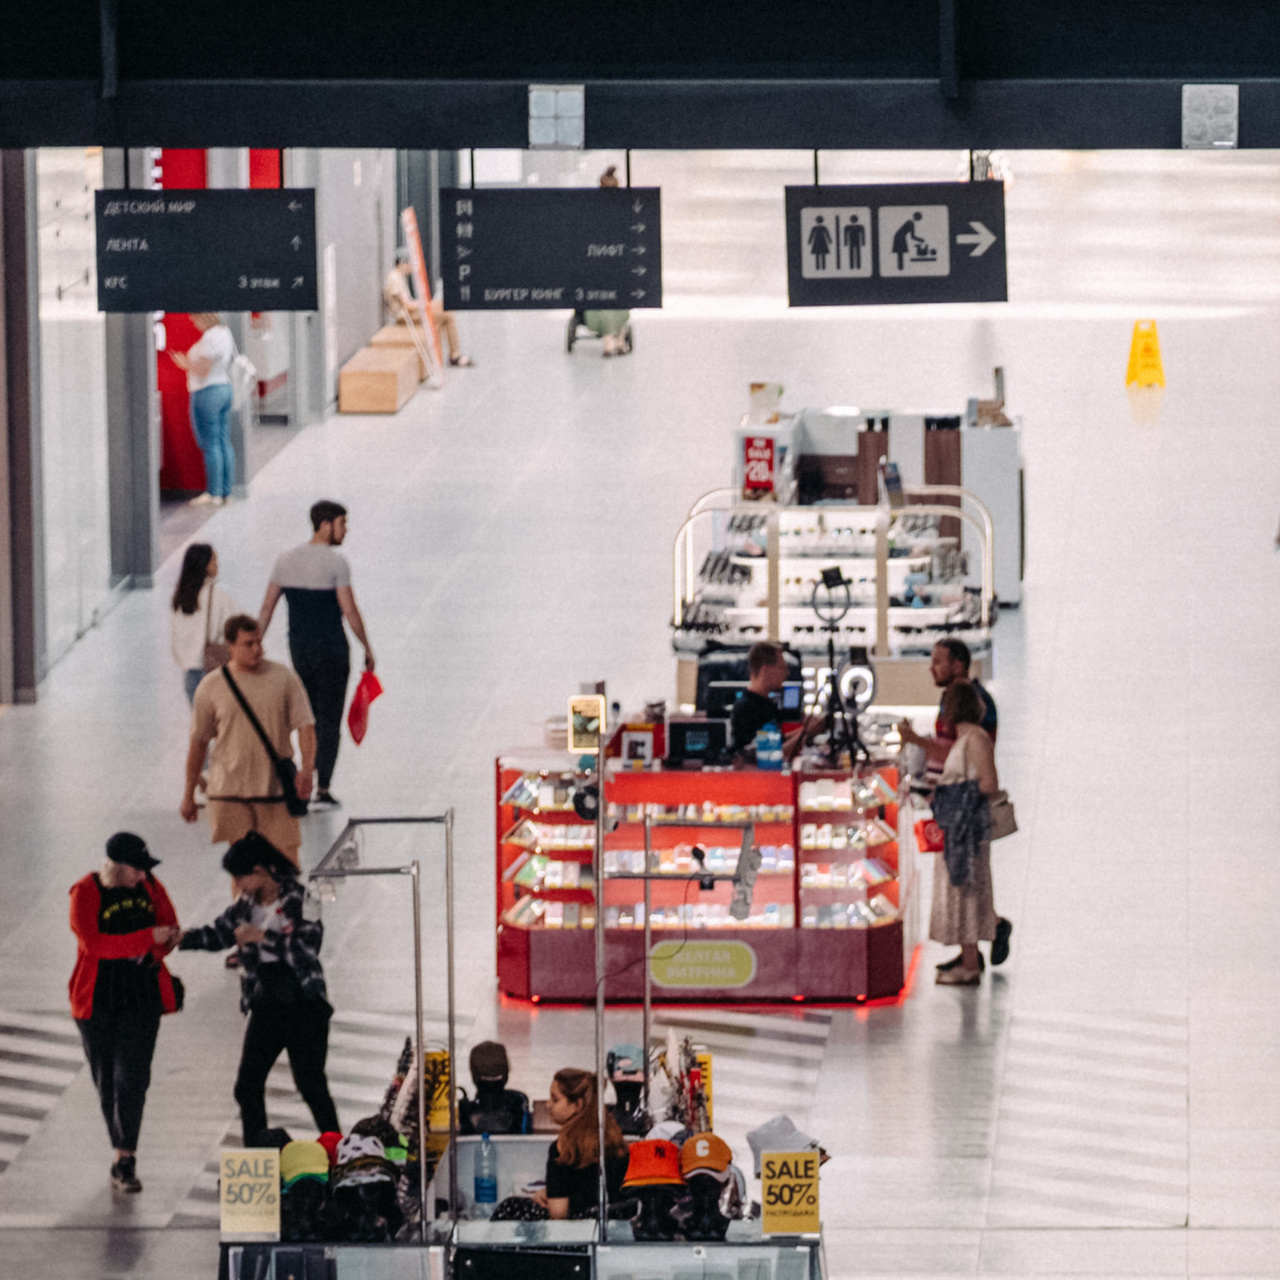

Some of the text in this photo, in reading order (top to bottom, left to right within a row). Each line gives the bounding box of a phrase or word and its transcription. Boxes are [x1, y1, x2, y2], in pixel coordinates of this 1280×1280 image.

[104, 199, 196, 216] ДЕТСКИЙ МИР
[105, 237, 149, 252] ЛЕНТА
[587, 243, 625, 257] ЛИФТ
[104, 276, 128, 289] KFC
[238, 275, 247, 289] 3
[484, 288, 565, 301] БУРГЕР КИНГ
[575, 288, 584, 301] 3
[225, 1159, 274, 1178] SALE
[765, 1160, 814, 1179] SALE
[225, 1183, 276, 1205] 50%
[765, 1182, 816, 1206] 50%
